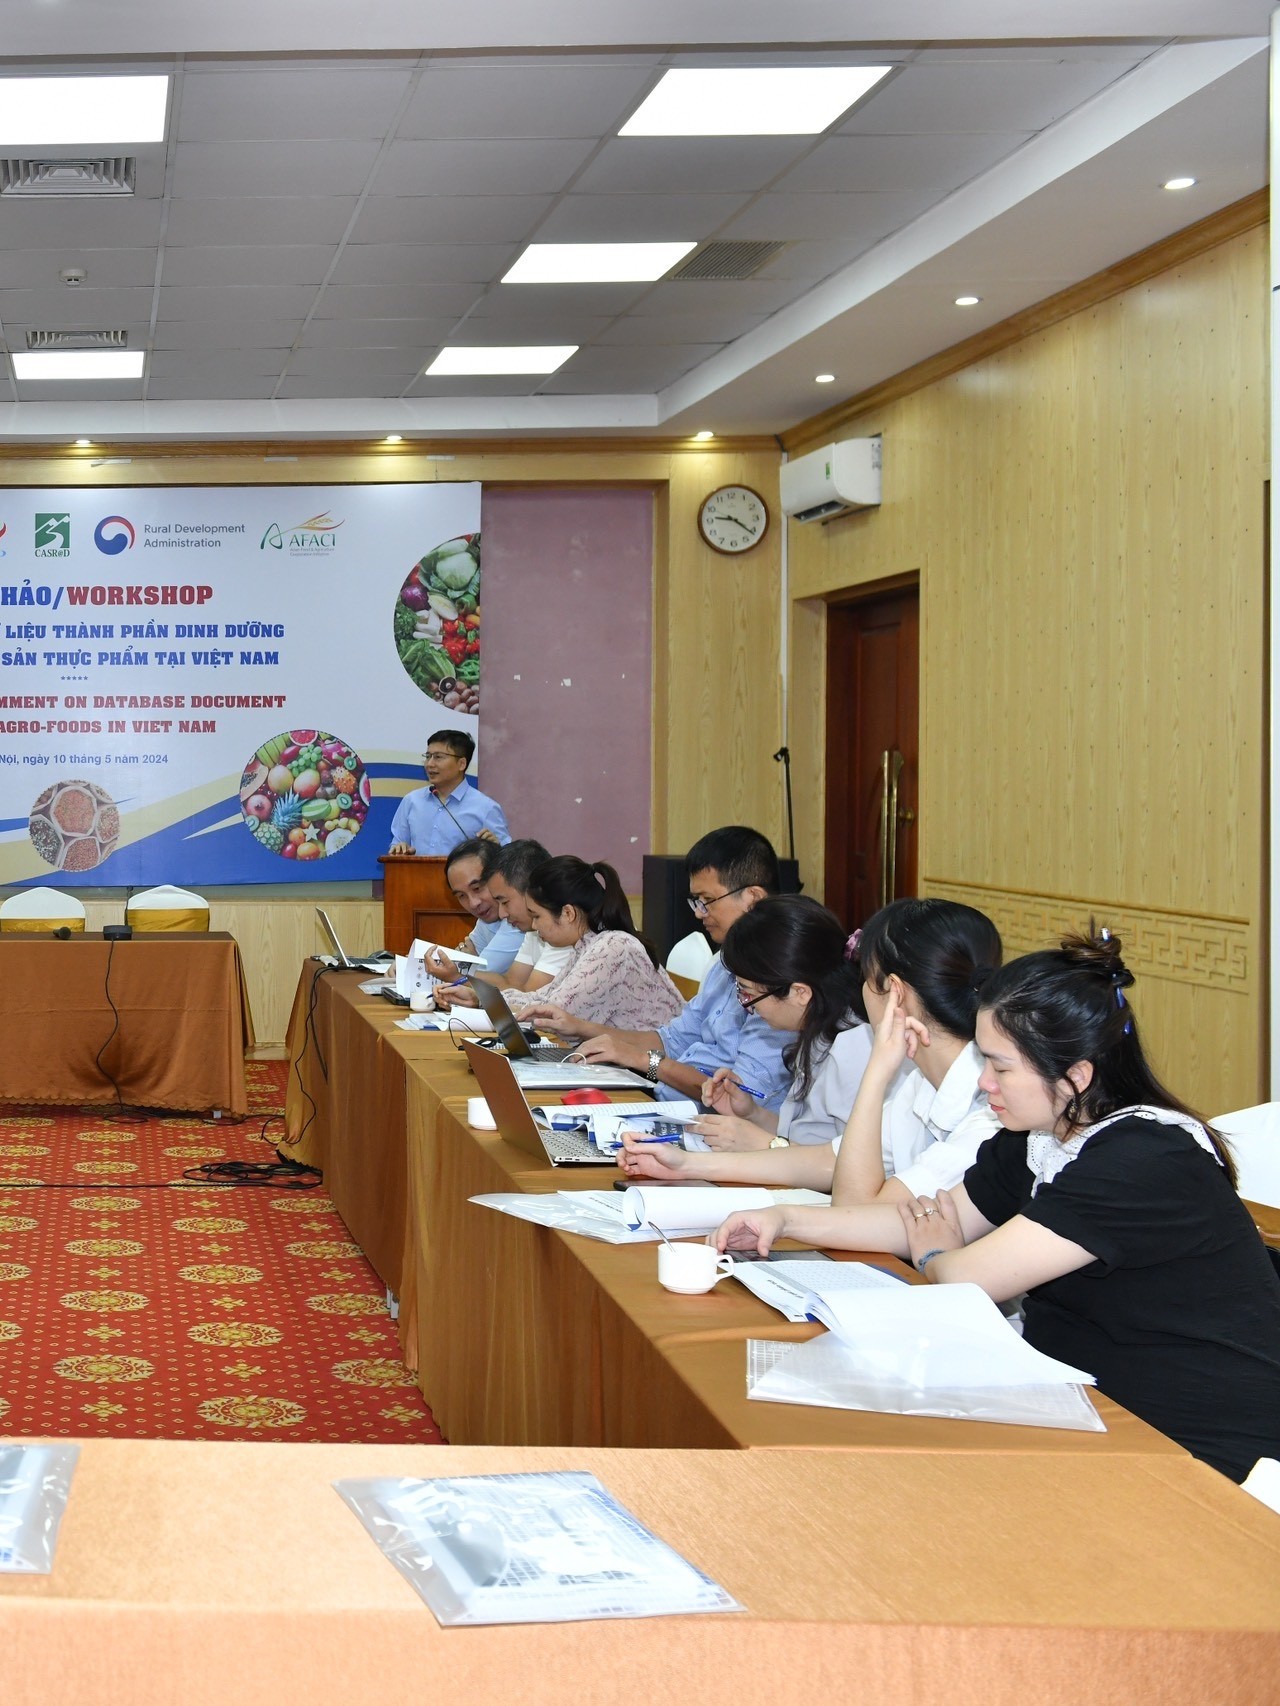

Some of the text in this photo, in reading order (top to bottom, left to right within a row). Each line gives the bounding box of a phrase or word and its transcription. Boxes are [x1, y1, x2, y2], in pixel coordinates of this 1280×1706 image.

[144, 524, 245, 536] Rural Development
[144, 538, 221, 548] Administration
[289, 533, 336, 547] AFACI
[5, 622, 46, 642] LIỆU
[52, 621, 114, 639] THÀNH
[120, 618, 169, 638] PHẦN
[175, 624, 219, 638] DINH
[225, 621, 285, 638] DƯỠNG
[2, 647, 37, 666] SẢN
[43, 648, 92, 669] THỰC
[97, 645, 149, 666] PHẨM
[155, 651, 186, 669] TẠI
[192, 648, 234, 669] VIỆT
[240, 651, 279, 665] NAM
[64, 696, 87, 709] ON
[93, 695, 185, 708] DATABASE
[191, 695, 286, 708] DOCUMENT
[108, 720, 126, 733] IN
[132, 720, 173, 733] VIET
[179, 720, 216, 733] NAM
[23, 755, 50, 766] ngày
[54, 755, 66, 764] 10
[69, 754, 102, 766] tháng
[105, 755, 112, 764] 5
[114, 754, 139, 764] năm
[142, 755, 169, 764] 2024
